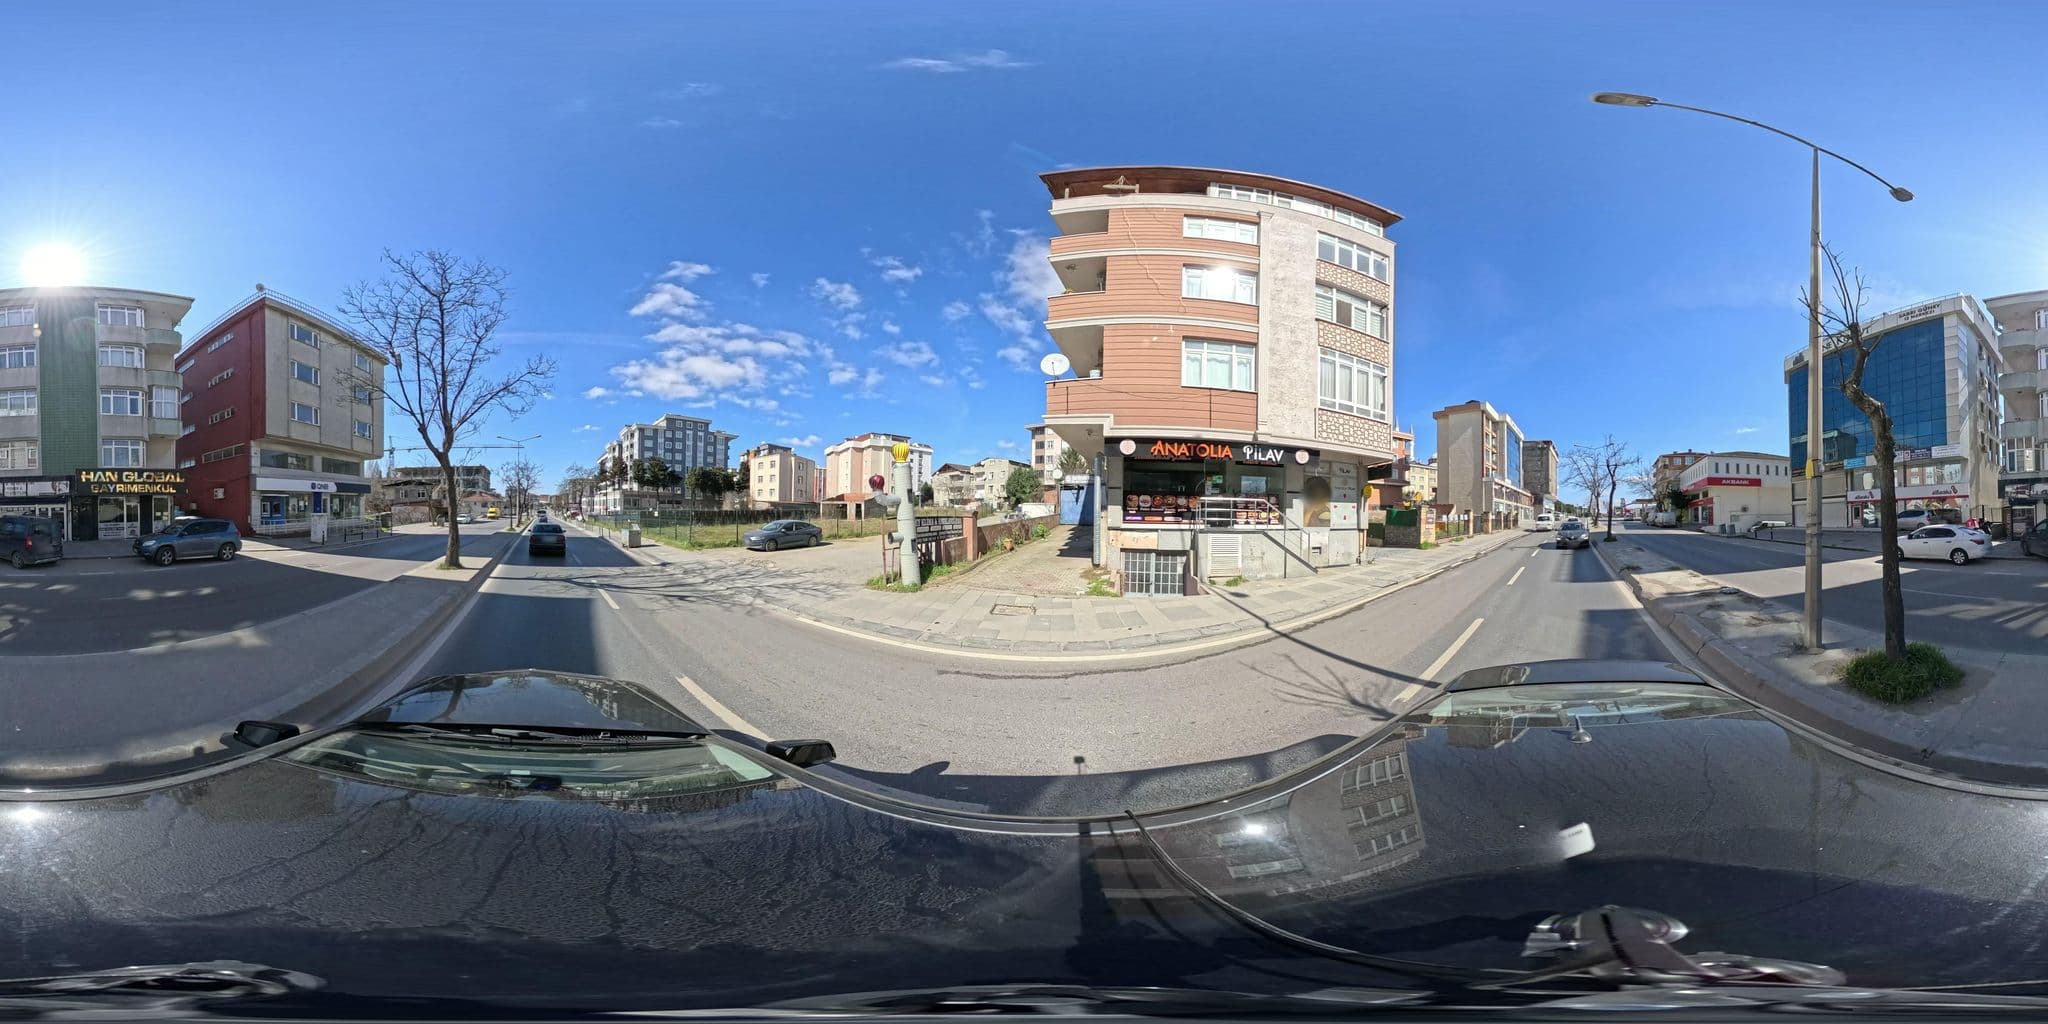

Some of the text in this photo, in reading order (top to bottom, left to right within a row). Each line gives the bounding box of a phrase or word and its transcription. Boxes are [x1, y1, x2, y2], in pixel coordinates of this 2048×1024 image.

[1151, 440, 1233, 459] ANATOLIA
[81, 471, 185, 483] HAN GLOBAL
